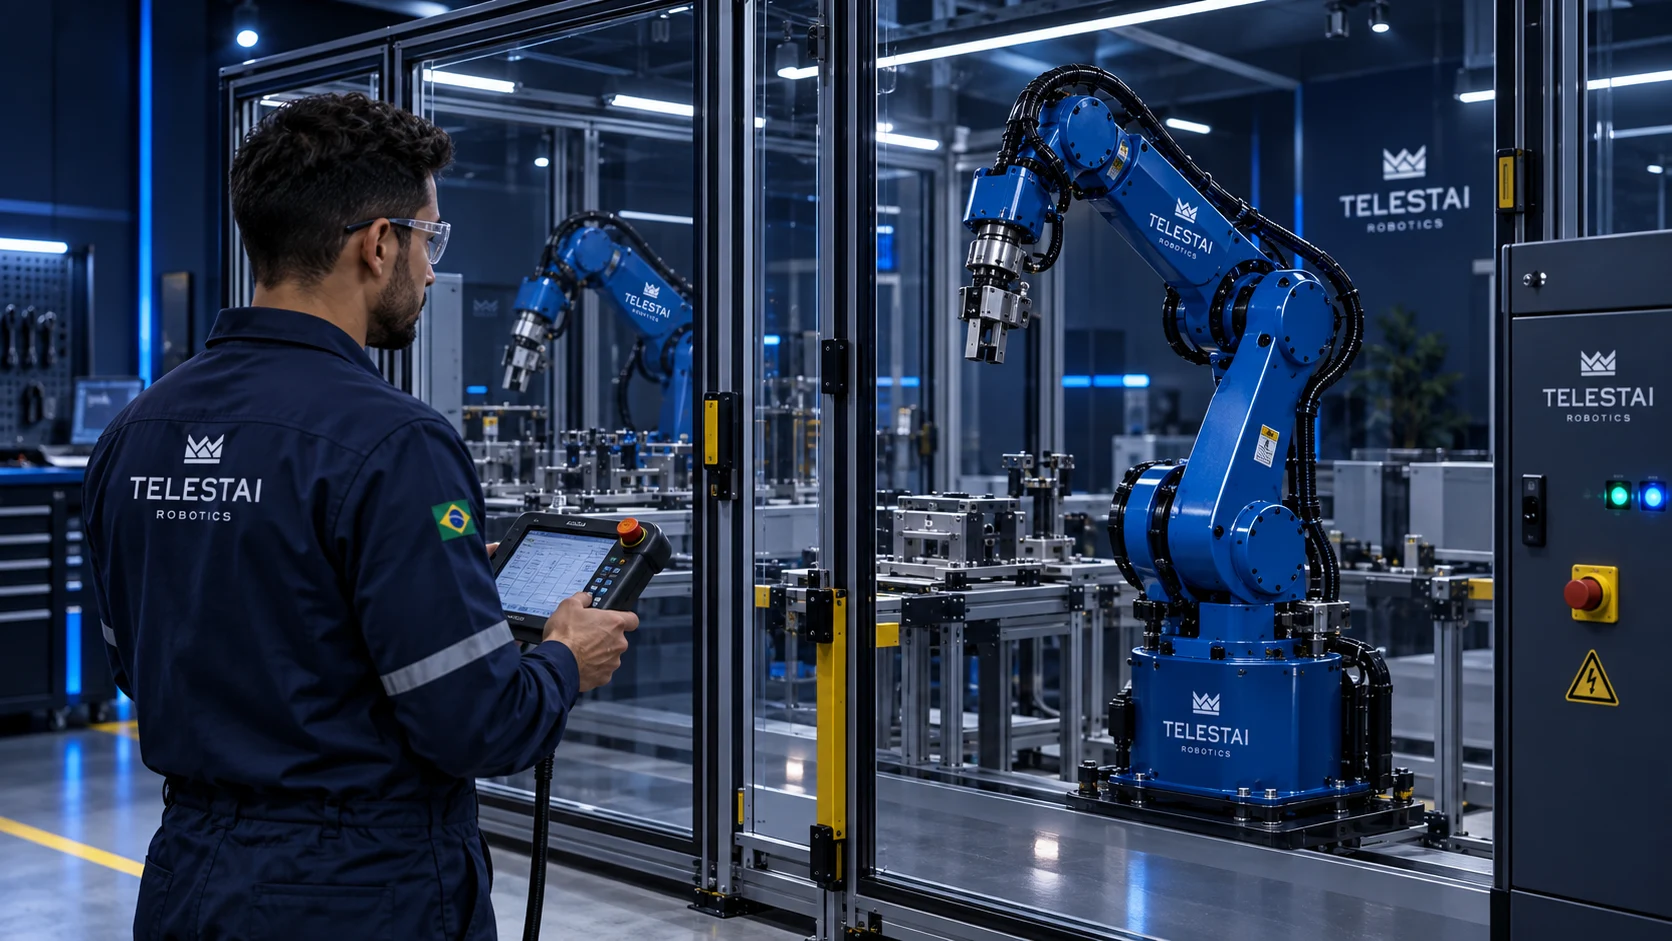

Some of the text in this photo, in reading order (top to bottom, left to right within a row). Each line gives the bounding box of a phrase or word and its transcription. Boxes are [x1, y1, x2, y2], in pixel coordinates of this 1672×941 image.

[1340, 186, 1470, 217] TELESTAI
[1149, 212, 1213, 255] TELESTAI
[1366, 218, 1444, 233] ROBOTICS
[625, 292, 671, 318] TELESTAI
[1543, 387, 1654, 407] TELESTAI
[1566, 413, 1631, 423] ROBOTICS
[130, 477, 262, 503] TELESTAI
[155, 510, 231, 522] ROBOTICS
[1163, 720, 1249, 746] TELESTAI
[1182, 745, 1230, 758] ROBOTICS
